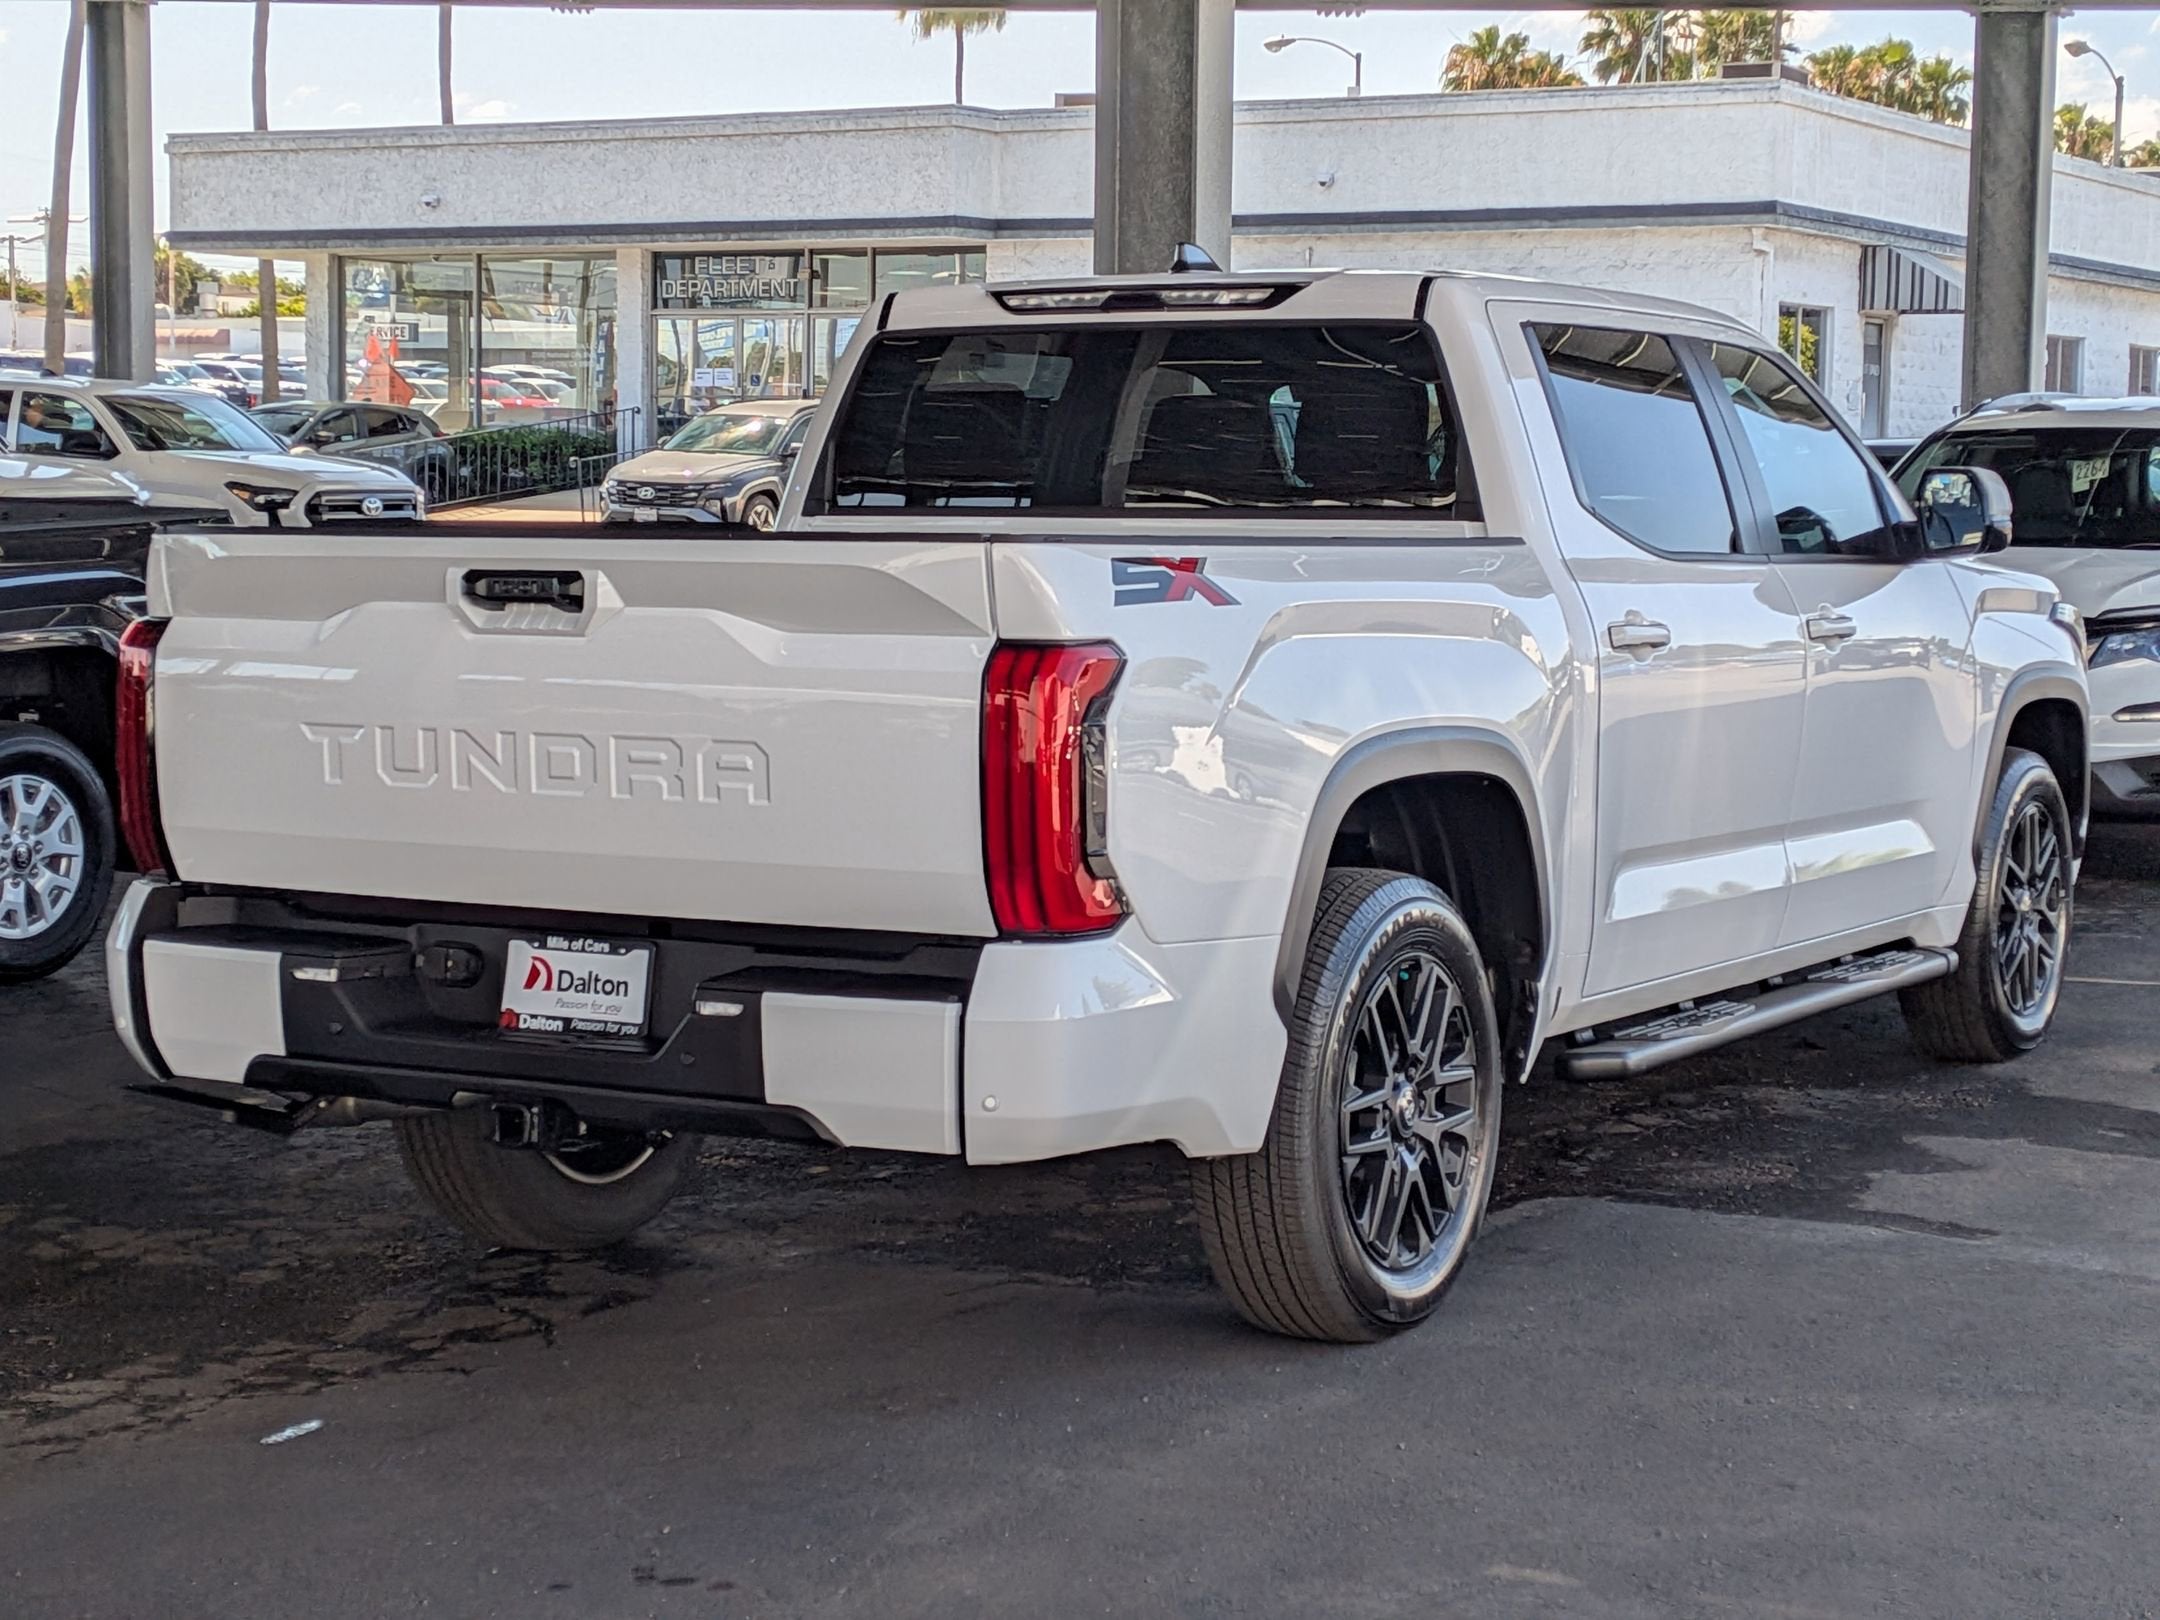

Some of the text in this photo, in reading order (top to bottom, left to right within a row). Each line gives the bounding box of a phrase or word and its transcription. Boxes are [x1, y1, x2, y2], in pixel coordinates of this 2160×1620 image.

[694, 255, 763, 275] FLEET
[661, 278, 799, 299] DEPARTMENT
[368, 326, 407, 339] ERVICE
[299, 721, 772, 806] TUNDRA
[556, 969, 629, 997] Dalton
[553, 998, 588, 1010] Passion
[604, 1002, 623, 1014] you
[518, 1014, 564, 1032] Dalton
[569, 1018, 605, 1032] Passion
[619, 1023, 639, 1036] you
